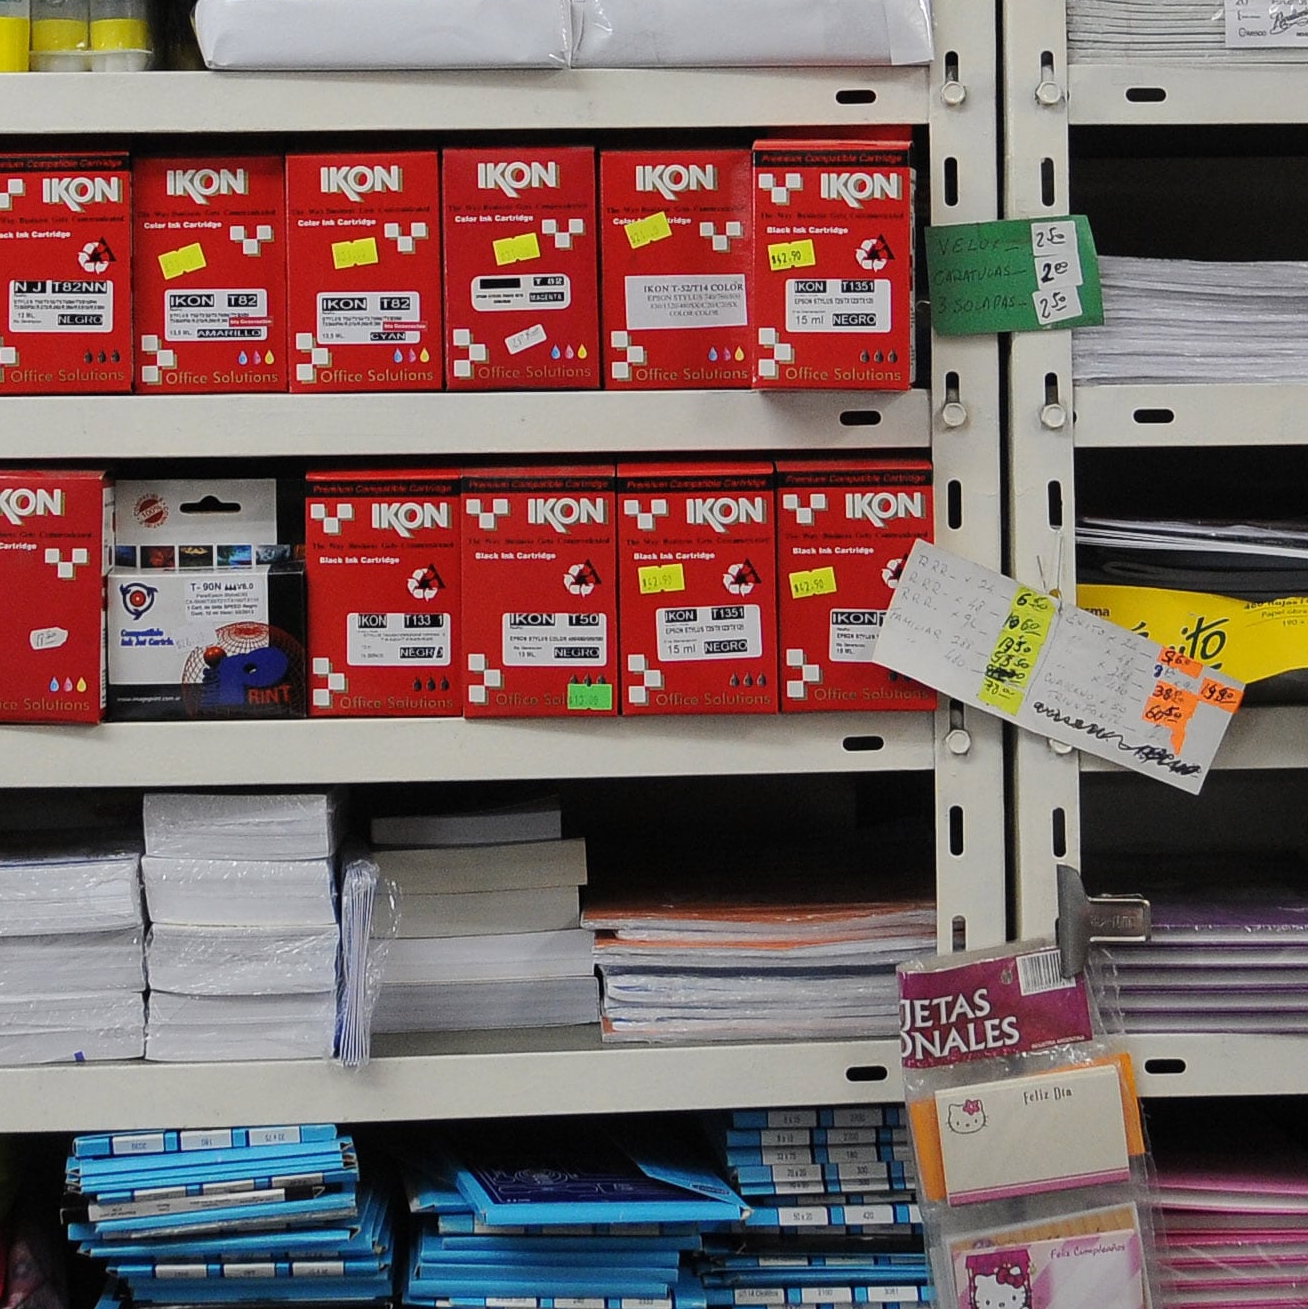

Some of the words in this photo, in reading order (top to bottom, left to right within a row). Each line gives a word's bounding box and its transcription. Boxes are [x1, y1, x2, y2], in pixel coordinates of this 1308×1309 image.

[166, 168, 249, 206] IKON
[320, 165, 403, 202] IKON
[477, 161, 560, 199] IKON
[635, 164, 718, 201] IKON
[42, 176, 123, 213] IKON
[820, 172, 902, 209] IKON
[767, 226, 791, 235] Black
[793, 226, 807, 234] Ink
[809, 226, 849, 235] Cartridge
[771, 250, 802, 265] $42.90
[52, 281, 107, 293] T82NN
[794, 281, 825, 293] IKON
[841, 281, 875, 293] T1351
[170, 295, 214, 307] IKON
[228, 294, 257, 306] T82
[322, 298, 367, 310] IKON
[380, 298, 411, 310] T82
[795, 315, 809, 325] 15
[812, 314, 824, 325] ml
[832, 314, 876, 326] NEGRO
[197, 328, 261, 338] AMARILLO
[370, 332, 405, 341] CYAN
[165, 372, 209, 385] Office
[213, 370, 278, 384] Solutions
[527, 498, 607, 534] IKON
[686, 497, 766, 534] IKON
[845, 492, 925, 528] IKON
[371, 502, 453, 538] IKON
[509, 614, 555, 625] IKON
[569, 614, 599, 624] T50
[555, 648, 599, 658] NEGRO
[1023, 1089, 1050, 1106] Feliz
[1051, 1248, 1071, 1260] Feliz
